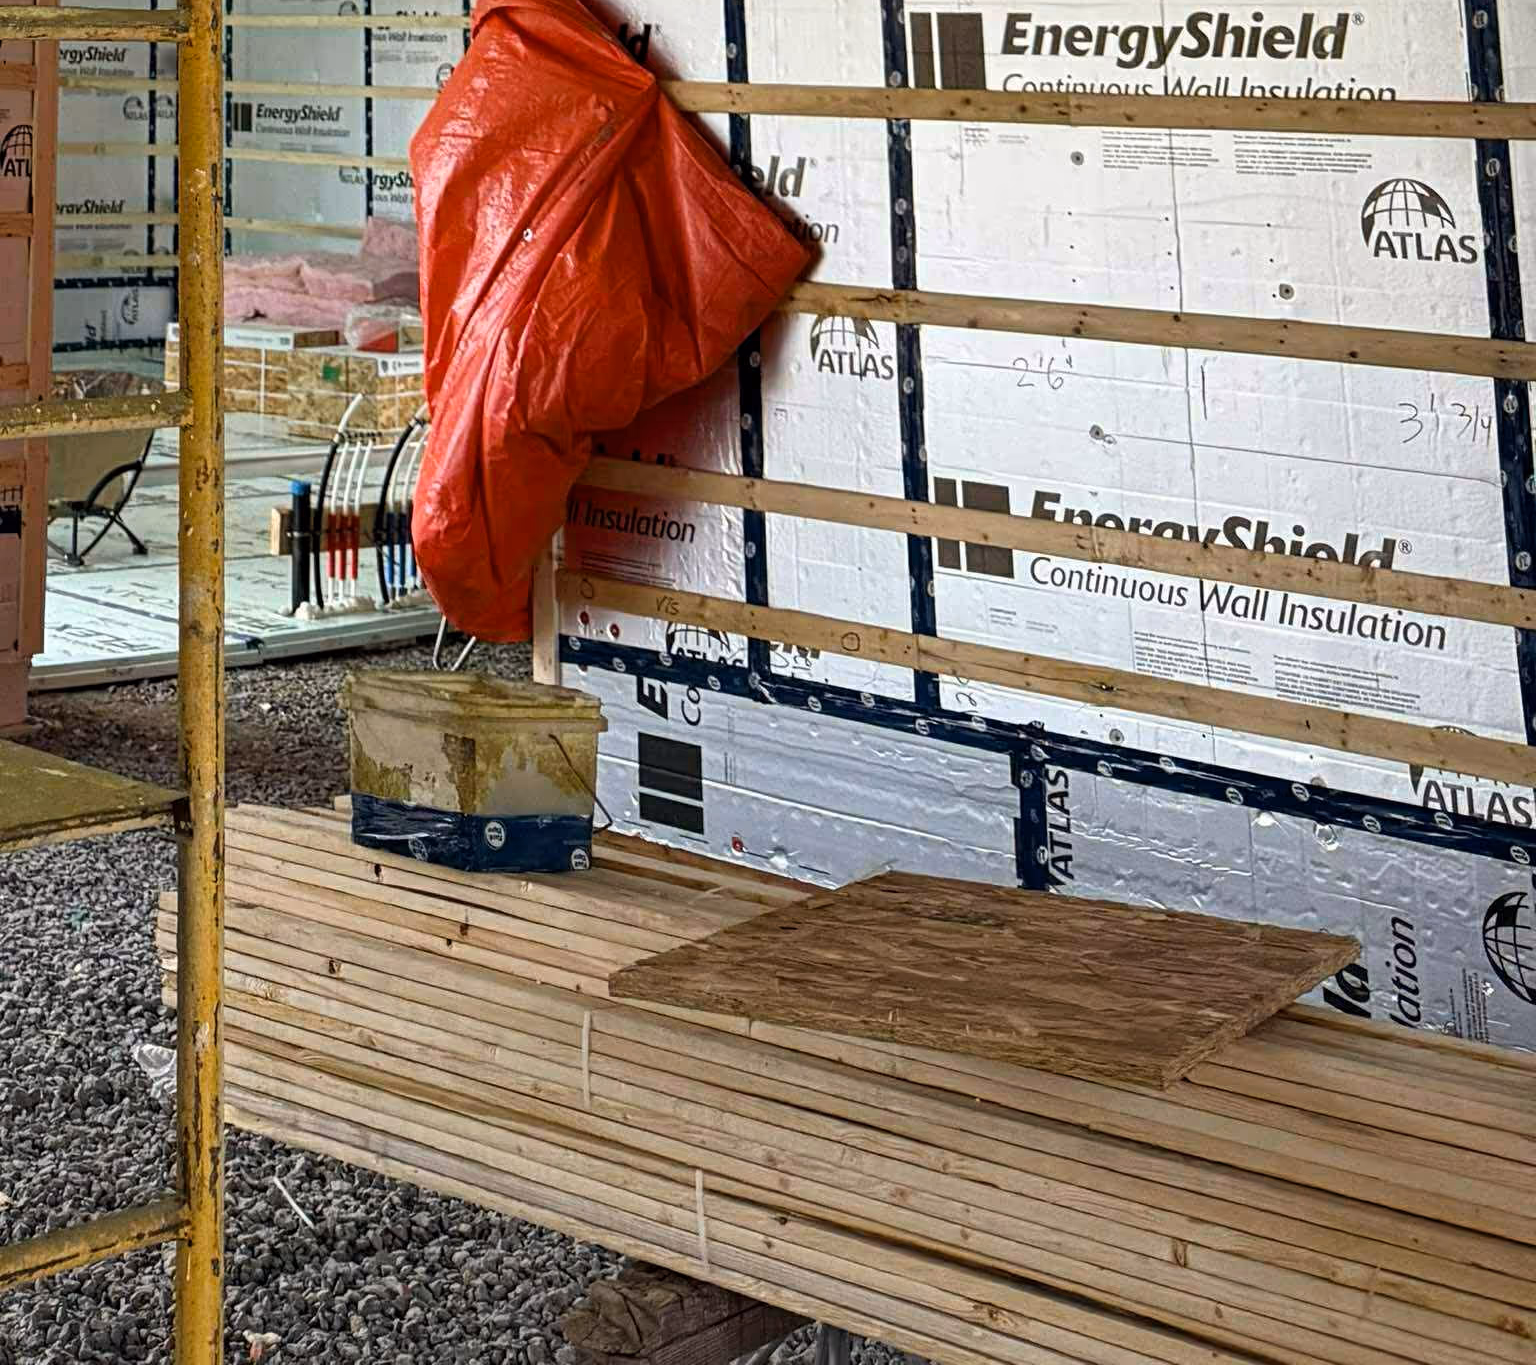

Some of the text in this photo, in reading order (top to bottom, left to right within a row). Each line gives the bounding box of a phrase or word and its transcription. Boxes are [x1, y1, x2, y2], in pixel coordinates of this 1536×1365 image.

[1002, 73, 1396, 102] Continuous Wall Insulation
[3, 158, 33, 178] ATL
[1373, 233, 1479, 265] ATLAS
[817, 348, 895, 381] ATLAS
[584, 502, 697, 545] Insulation
[1030, 556, 1447, 651] Continuous Wall Insulation
[1422, 777, 1534, 830] ATLAS
[1045, 769, 1074, 882] ATLAS
